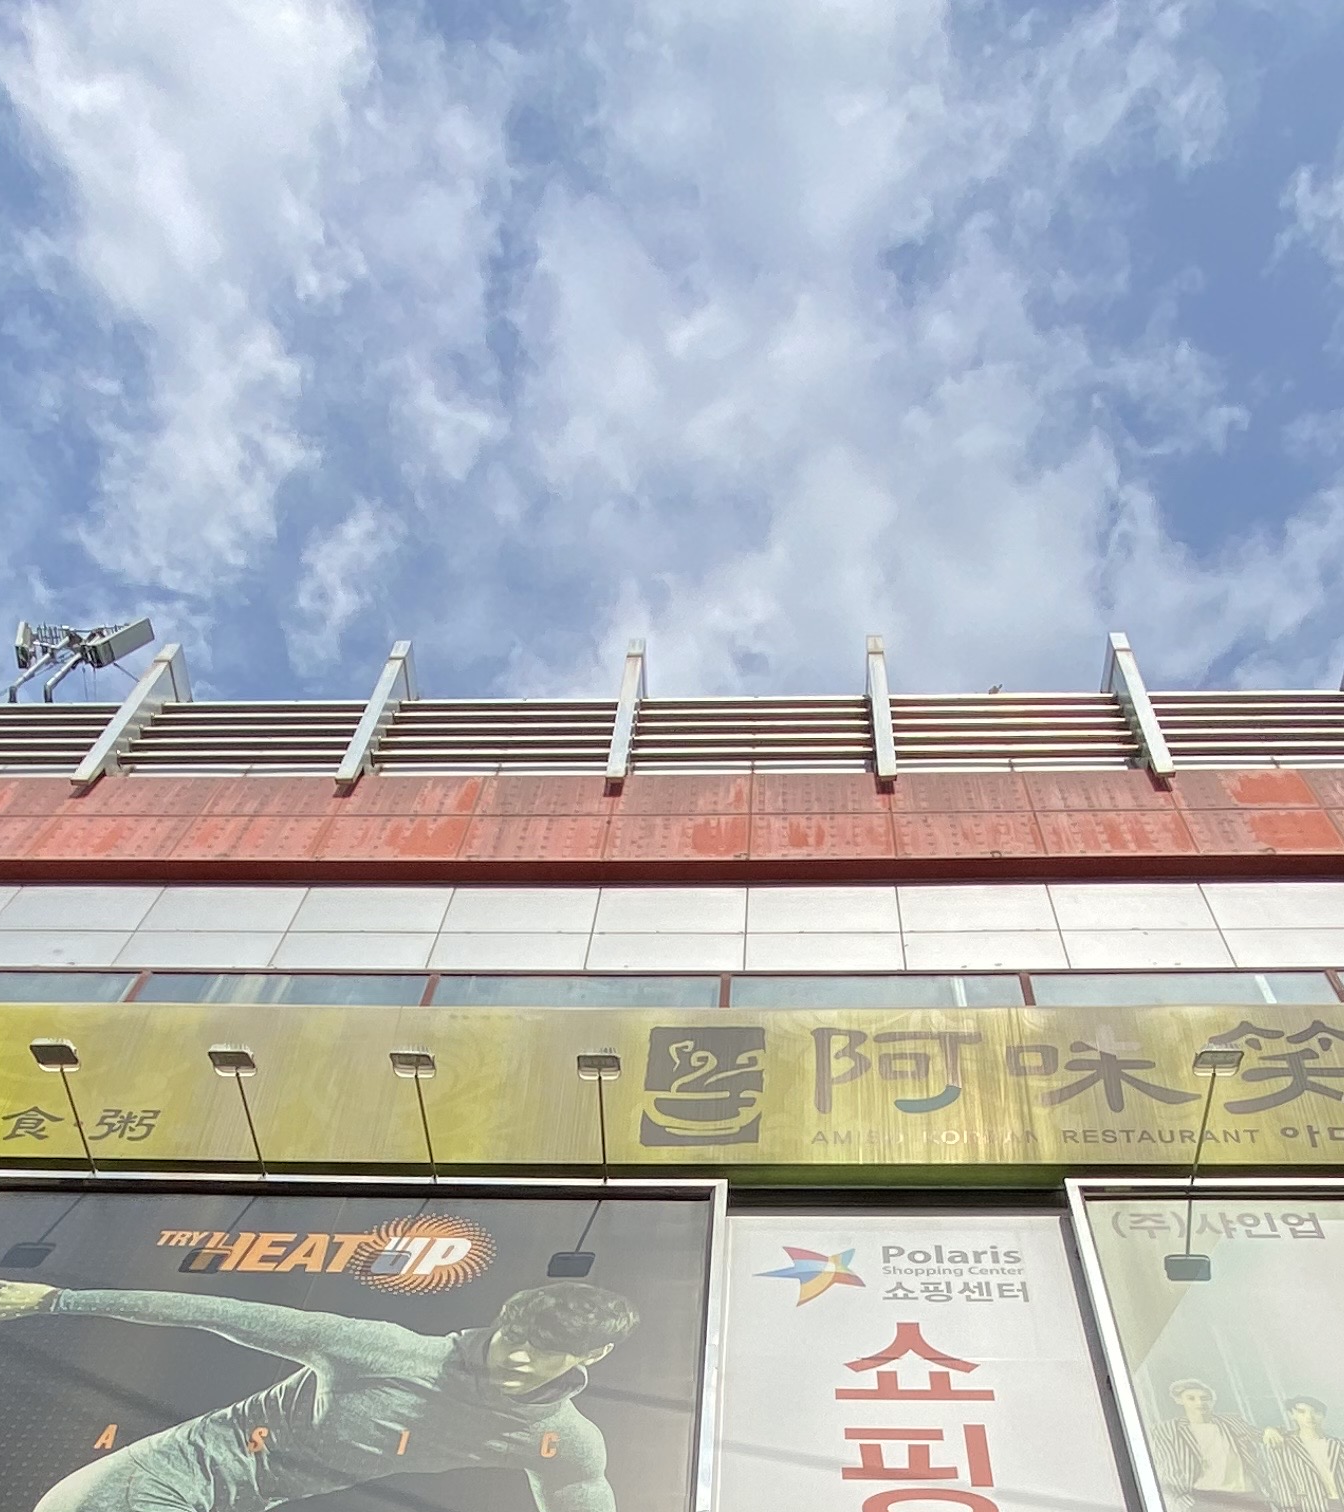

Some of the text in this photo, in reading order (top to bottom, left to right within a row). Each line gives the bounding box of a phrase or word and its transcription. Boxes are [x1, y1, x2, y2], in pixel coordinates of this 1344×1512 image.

[1061, 1128, 1261, 1146] RESTAURANT
[200, 1229, 380, 1274] HEAT
[881, 1244, 1023, 1266] Polaris
[881, 1265, 1025, 1278] Shopping Center
[881, 1280, 1031, 1303] 쇼핑센터
